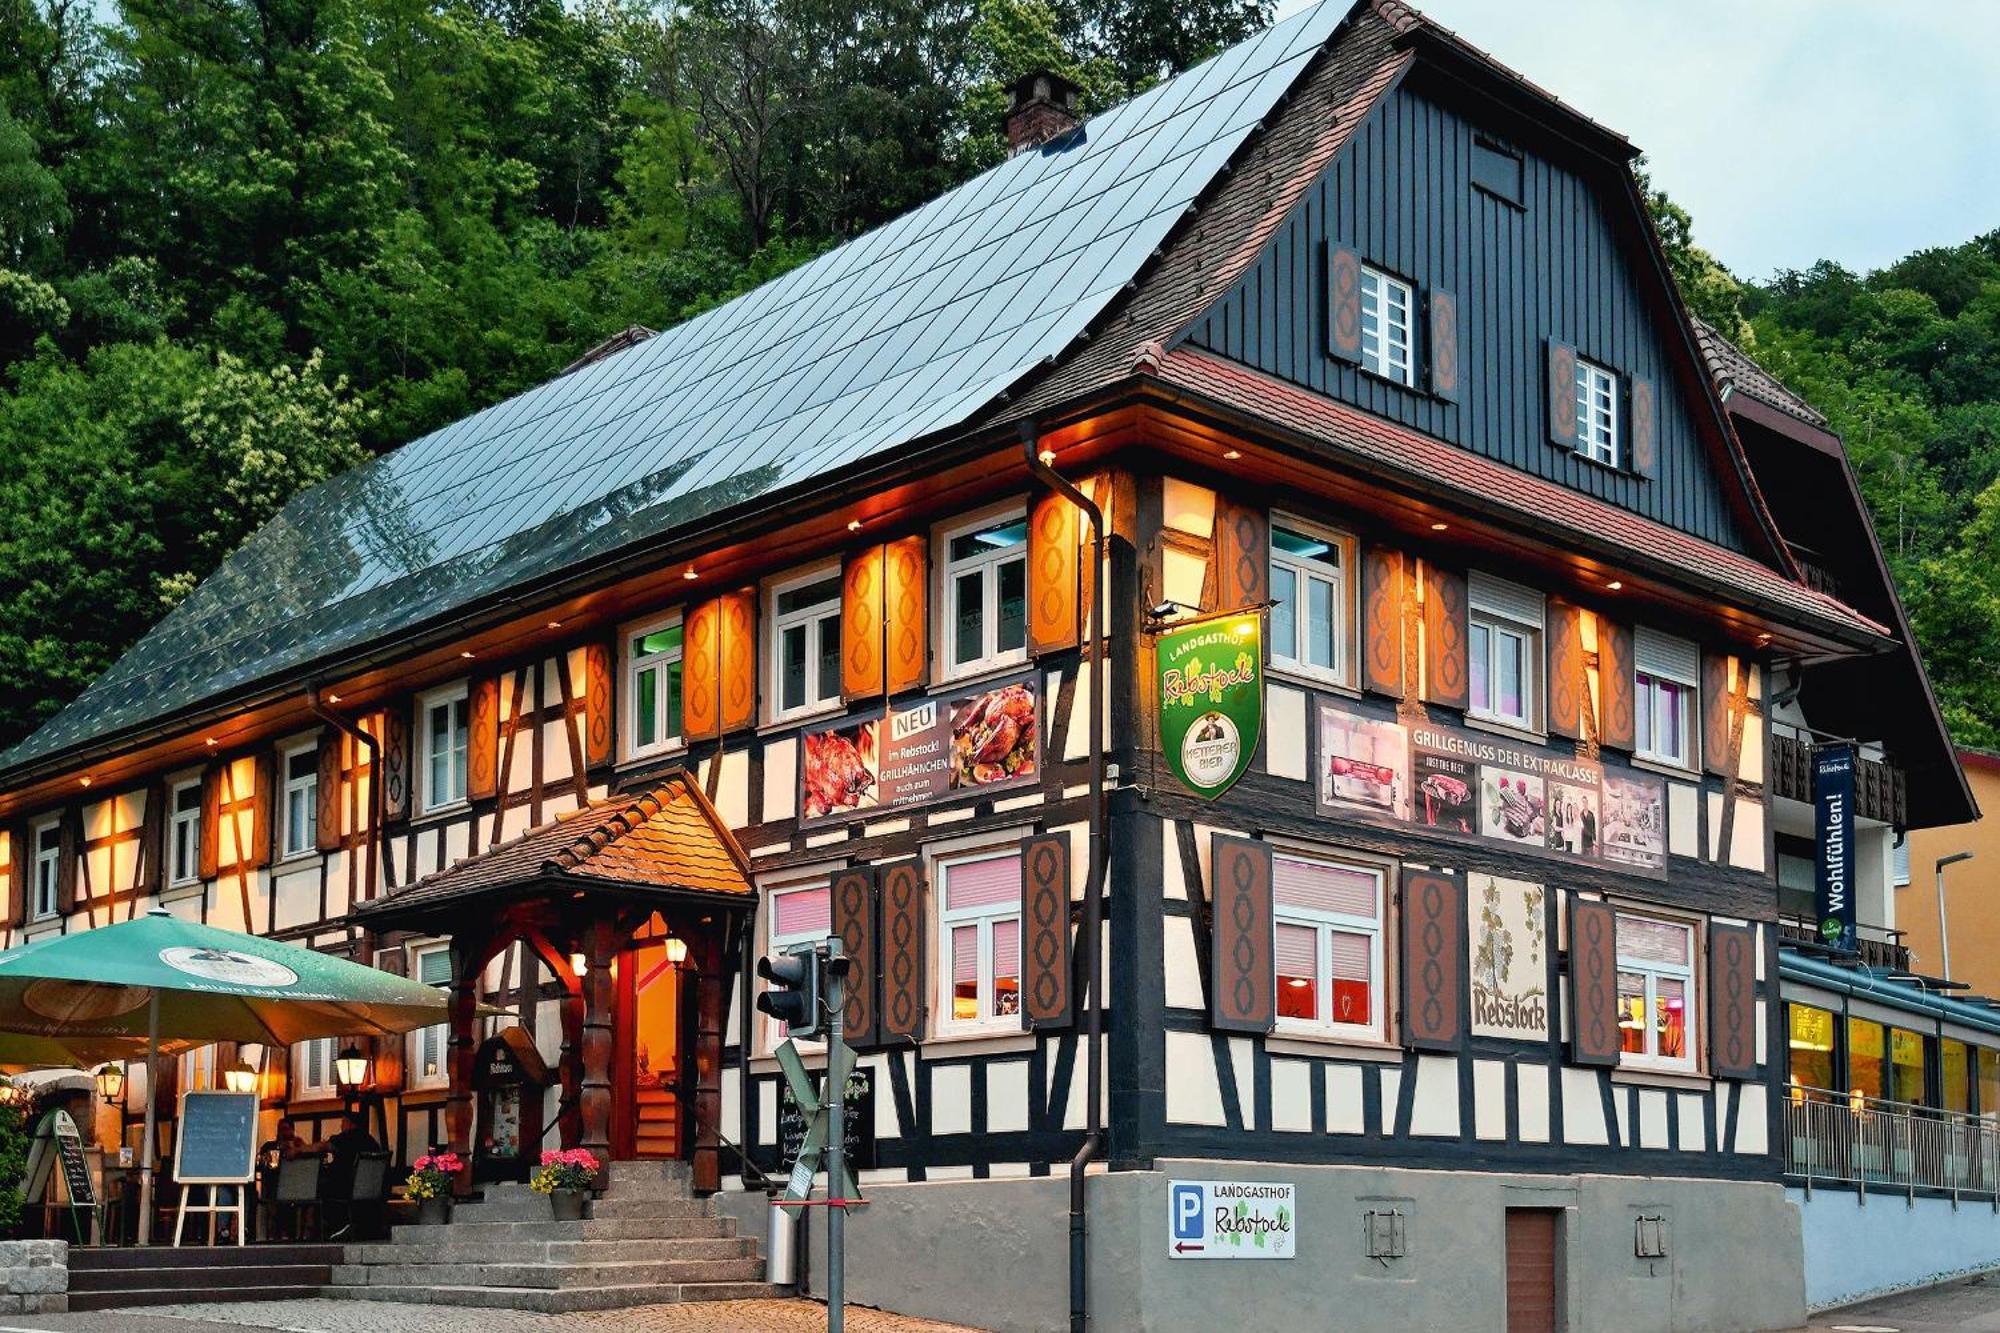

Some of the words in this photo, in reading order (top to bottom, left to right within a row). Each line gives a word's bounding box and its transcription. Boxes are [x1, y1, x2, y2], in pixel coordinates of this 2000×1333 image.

[1169, 632, 1245, 662] LANDGASTHOF
[1164, 660, 1255, 701] Rebstock
[896, 705, 931, 735] NEU
[888, 750, 899, 762] im
[1186, 742, 1237, 759] KETTERER
[1199, 756, 1223, 769] BIER
[1413, 729, 1495, 761] GRILLGENUSS
[1498, 748, 1521, 767] DER
[1523, 754, 1599, 785] EXTRAKLASSE
[895, 781, 913, 793] auch
[914, 779, 930, 790] zum
[1825, 793, 1844, 913] Wohlfühlen!
[1472, 988, 1546, 1031] Rebstock
[1214, 1185, 1291, 1199] LANDGASTHOF
[1179, 1191, 1201, 1232] P
[1215, 1206, 1291, 1235] Rebstock
